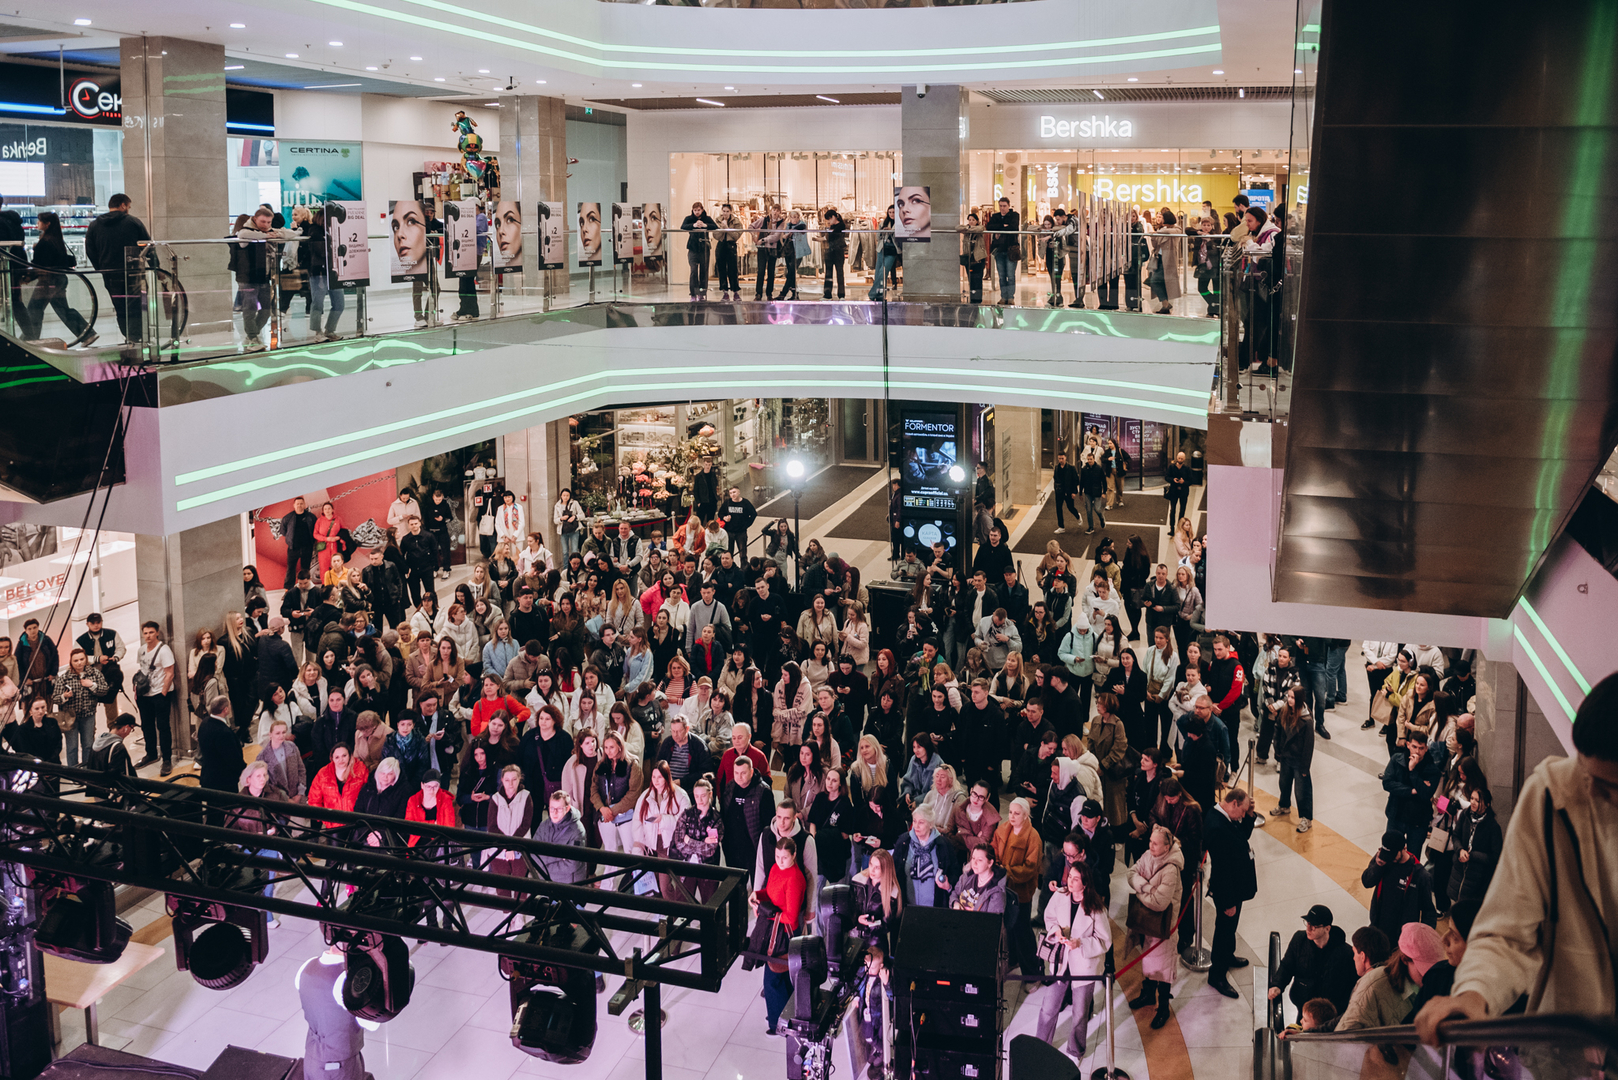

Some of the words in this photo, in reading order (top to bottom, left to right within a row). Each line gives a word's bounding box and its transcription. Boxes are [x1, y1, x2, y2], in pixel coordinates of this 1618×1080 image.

[1040, 114, 1132, 138] Bershka
[1046, 166, 1059, 198] BSK
[1097, 178, 1203, 203] Bershka
[904, 422, 954, 432] FORMENTOR
[106, 640, 114, 649] W
